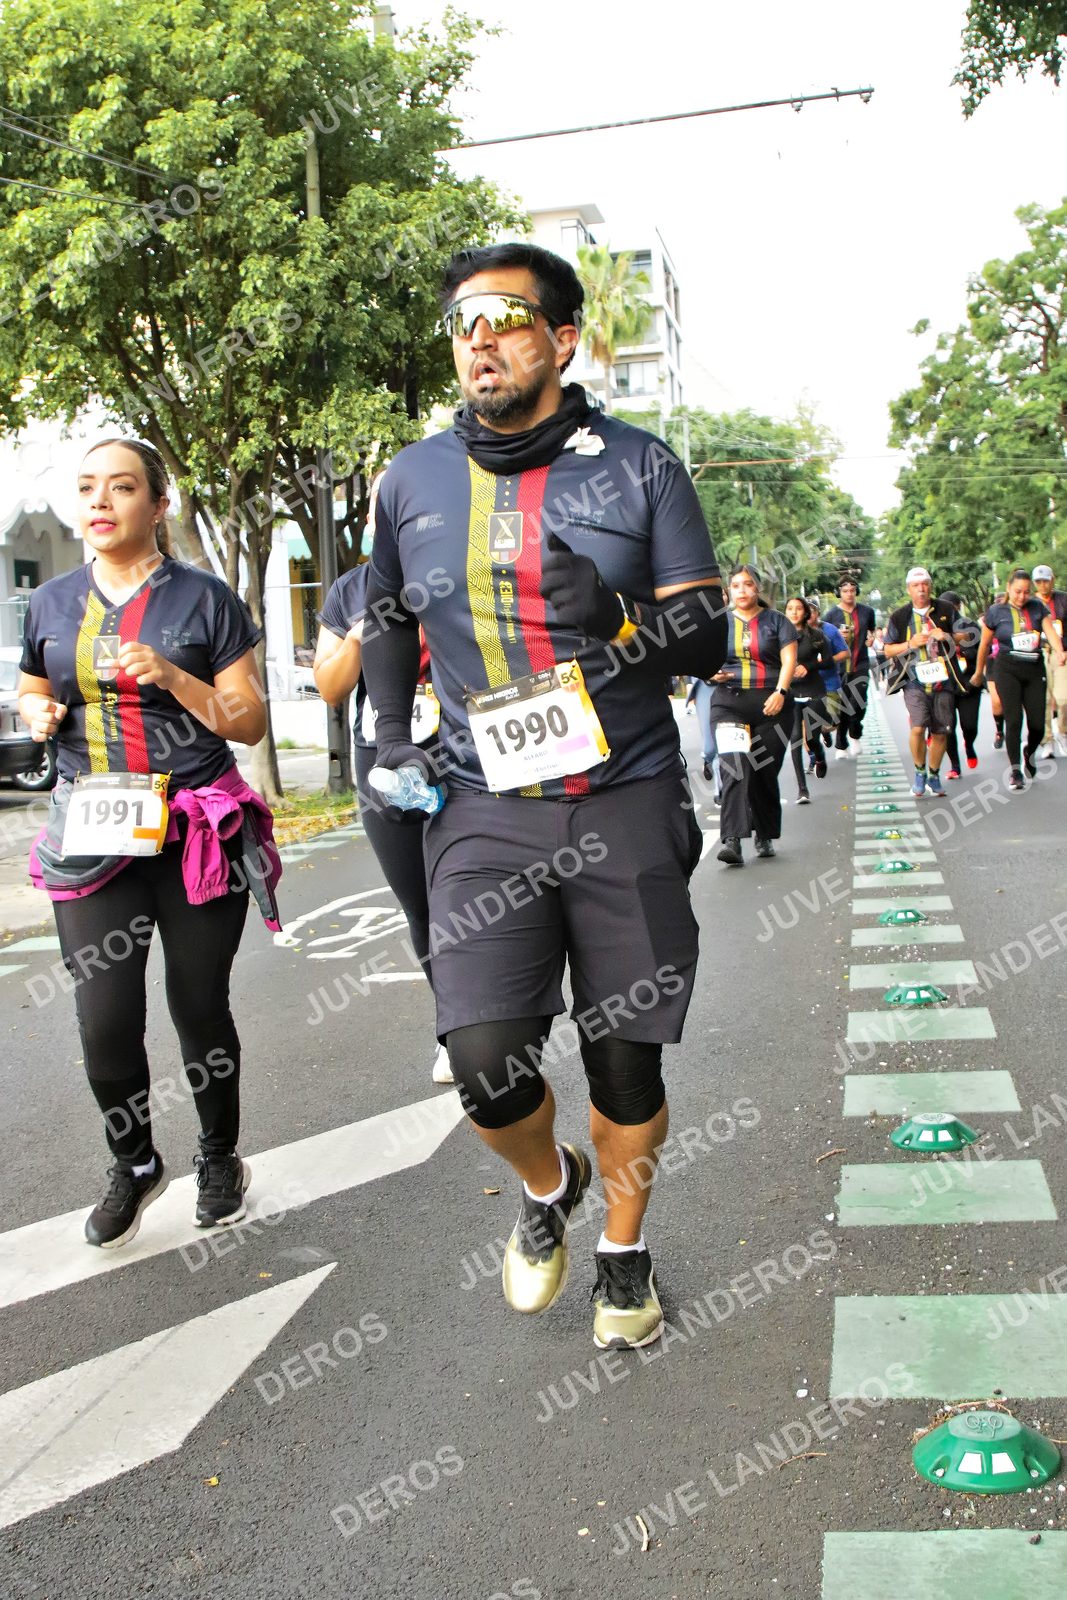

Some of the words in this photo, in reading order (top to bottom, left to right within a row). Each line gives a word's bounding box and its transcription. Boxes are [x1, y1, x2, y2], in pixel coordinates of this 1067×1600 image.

[561, 669, 579, 684] 5K
[485, 704, 569, 756] 1990
[154, 780, 167, 790] 5K
[81, 799, 144, 826] 1991
